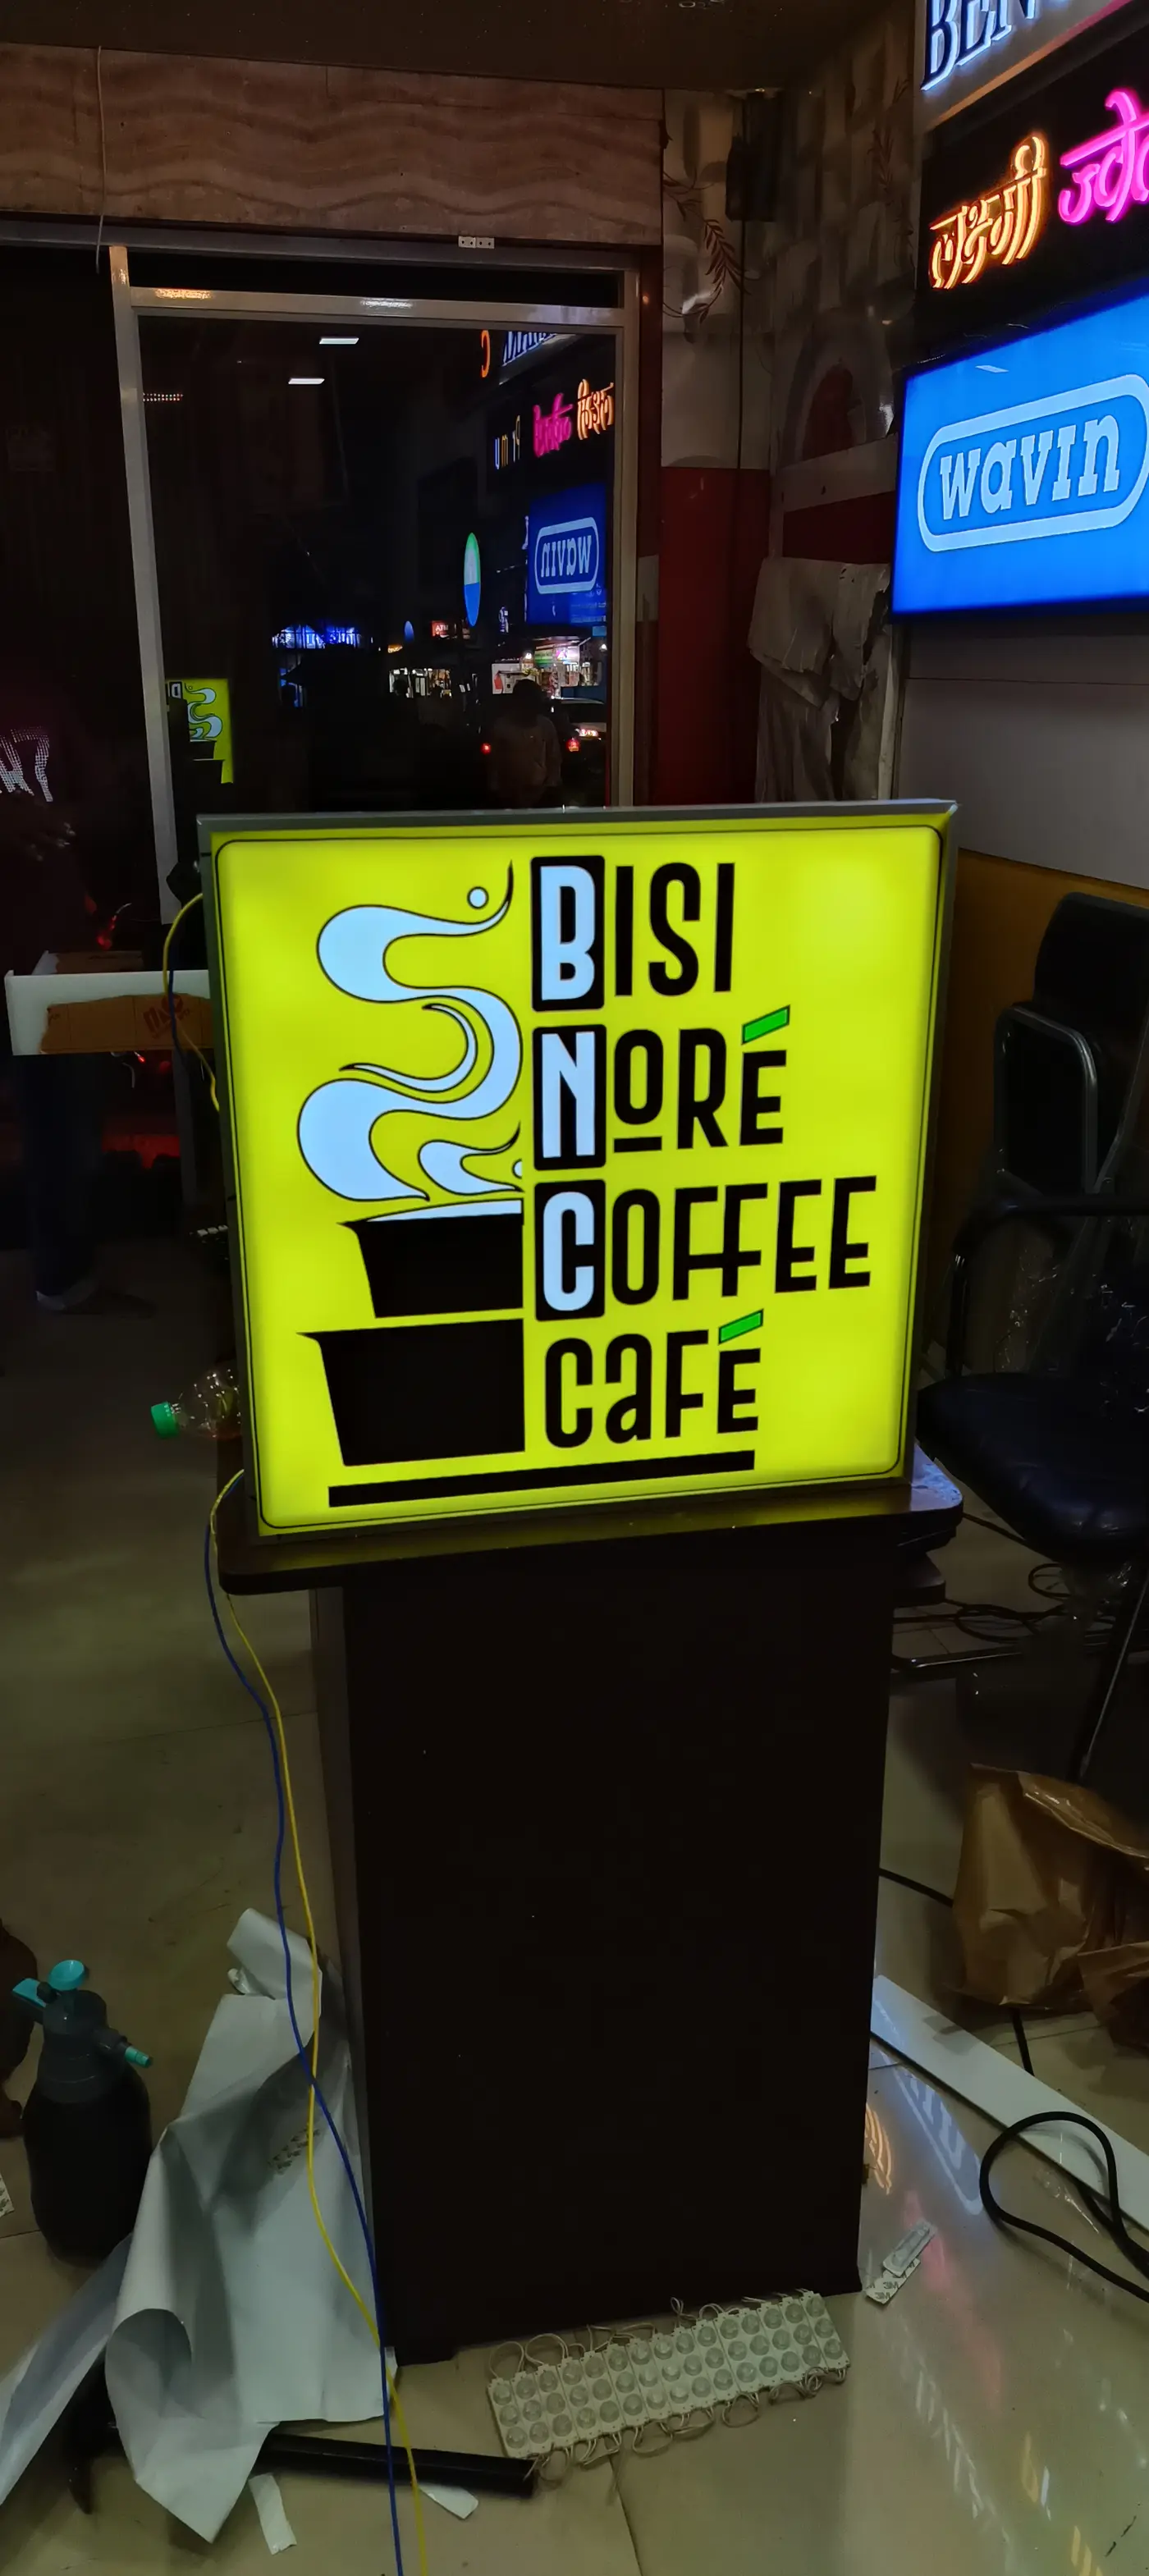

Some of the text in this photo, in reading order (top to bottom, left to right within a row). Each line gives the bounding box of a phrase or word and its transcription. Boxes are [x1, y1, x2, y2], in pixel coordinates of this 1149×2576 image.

[940, 415, 1119, 520] wavin
[539, 862, 735, 1001] BISI
[542, 1175, 877, 1311] COFFEE
